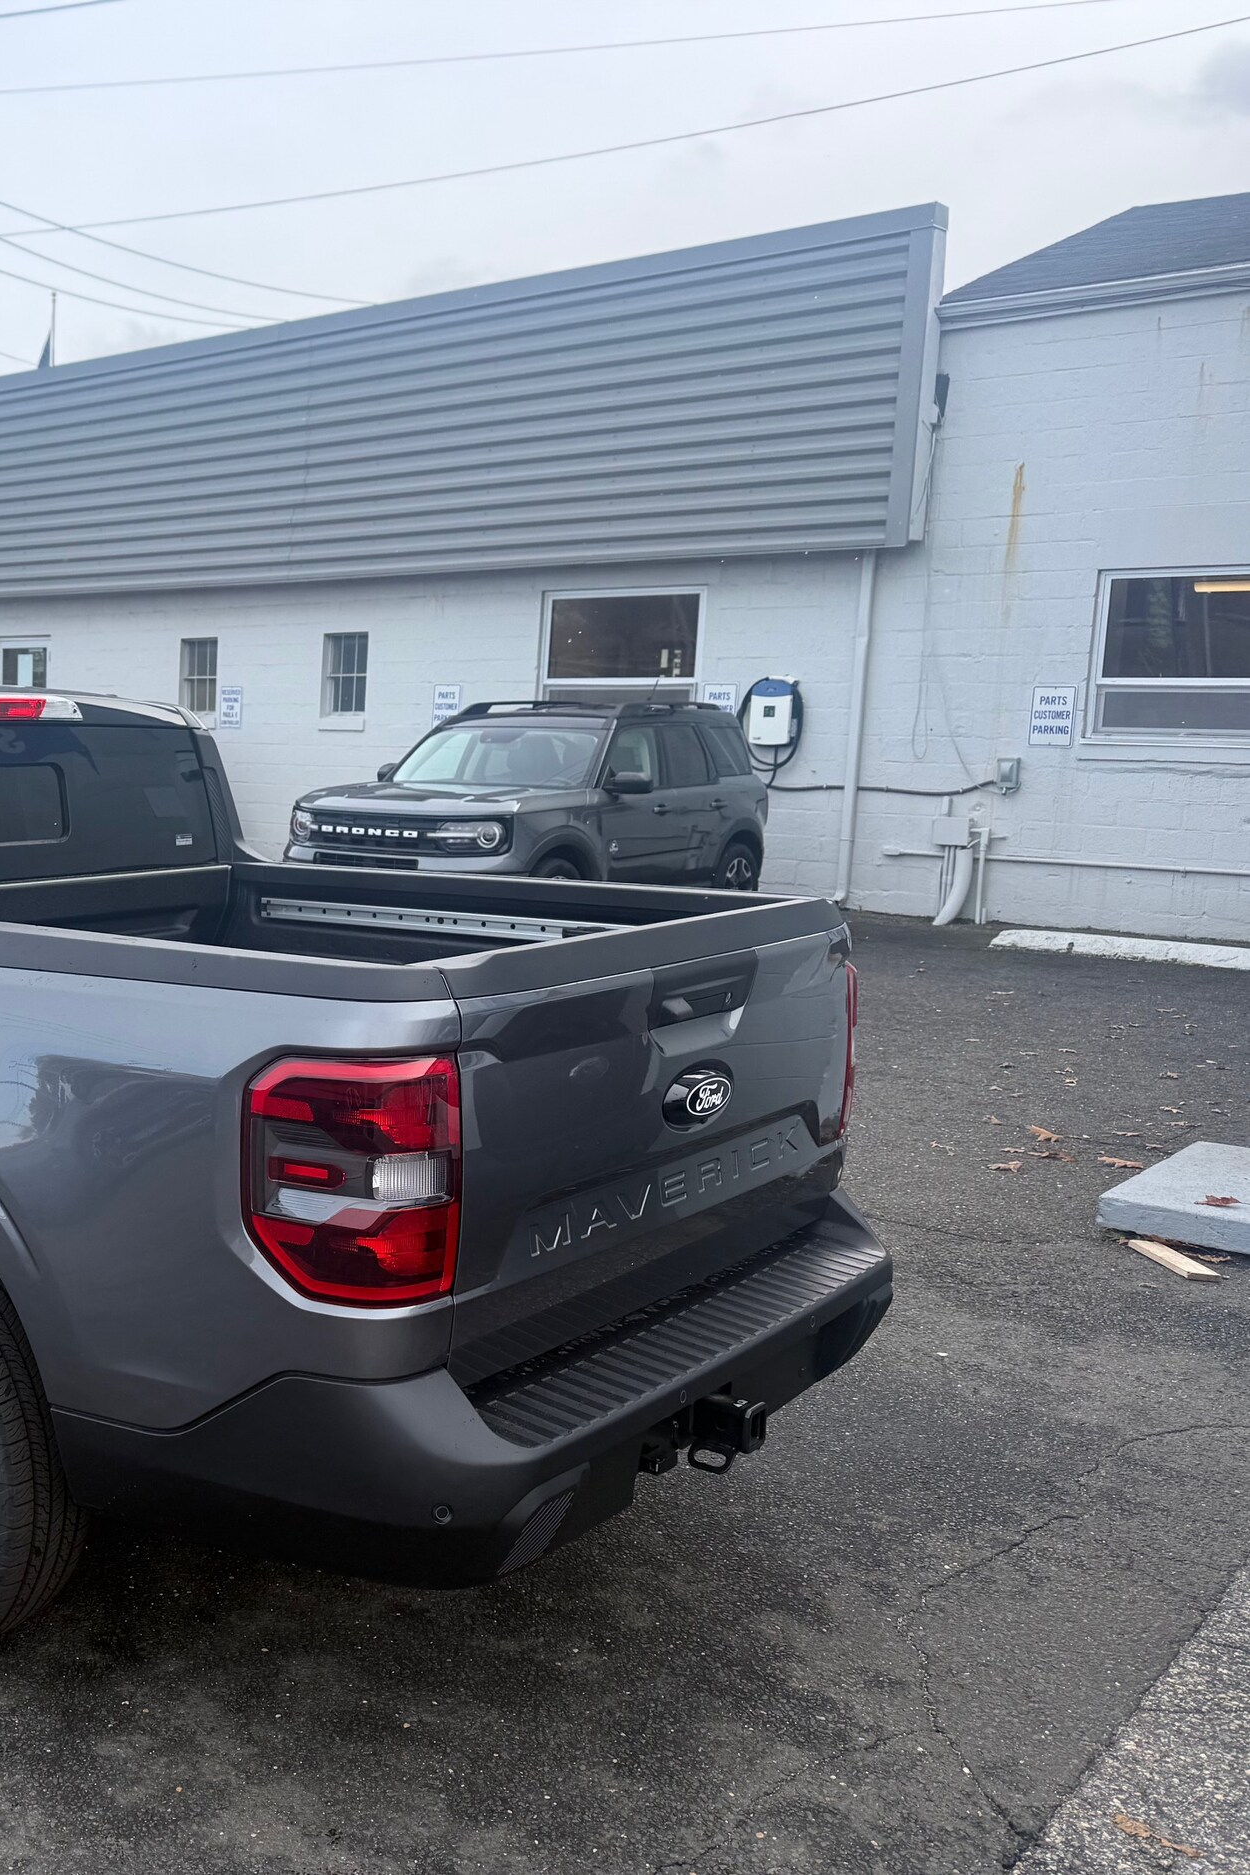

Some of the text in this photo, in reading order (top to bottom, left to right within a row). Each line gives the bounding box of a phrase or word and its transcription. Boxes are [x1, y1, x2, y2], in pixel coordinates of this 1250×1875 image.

[438, 691, 456, 700] PARTS
[709, 692, 731, 701] PARTS
[1040, 695, 1068, 706] PARTS
[435, 702, 458, 711] CUSTOMER
[1034, 710, 1071, 720] CUSTOMER
[1032, 725, 1070, 735] PARKING
[320, 824, 419, 839] BRONCO
[693, 1080, 726, 1112] Ford
[528, 1117, 801, 1258] MAVERICK
